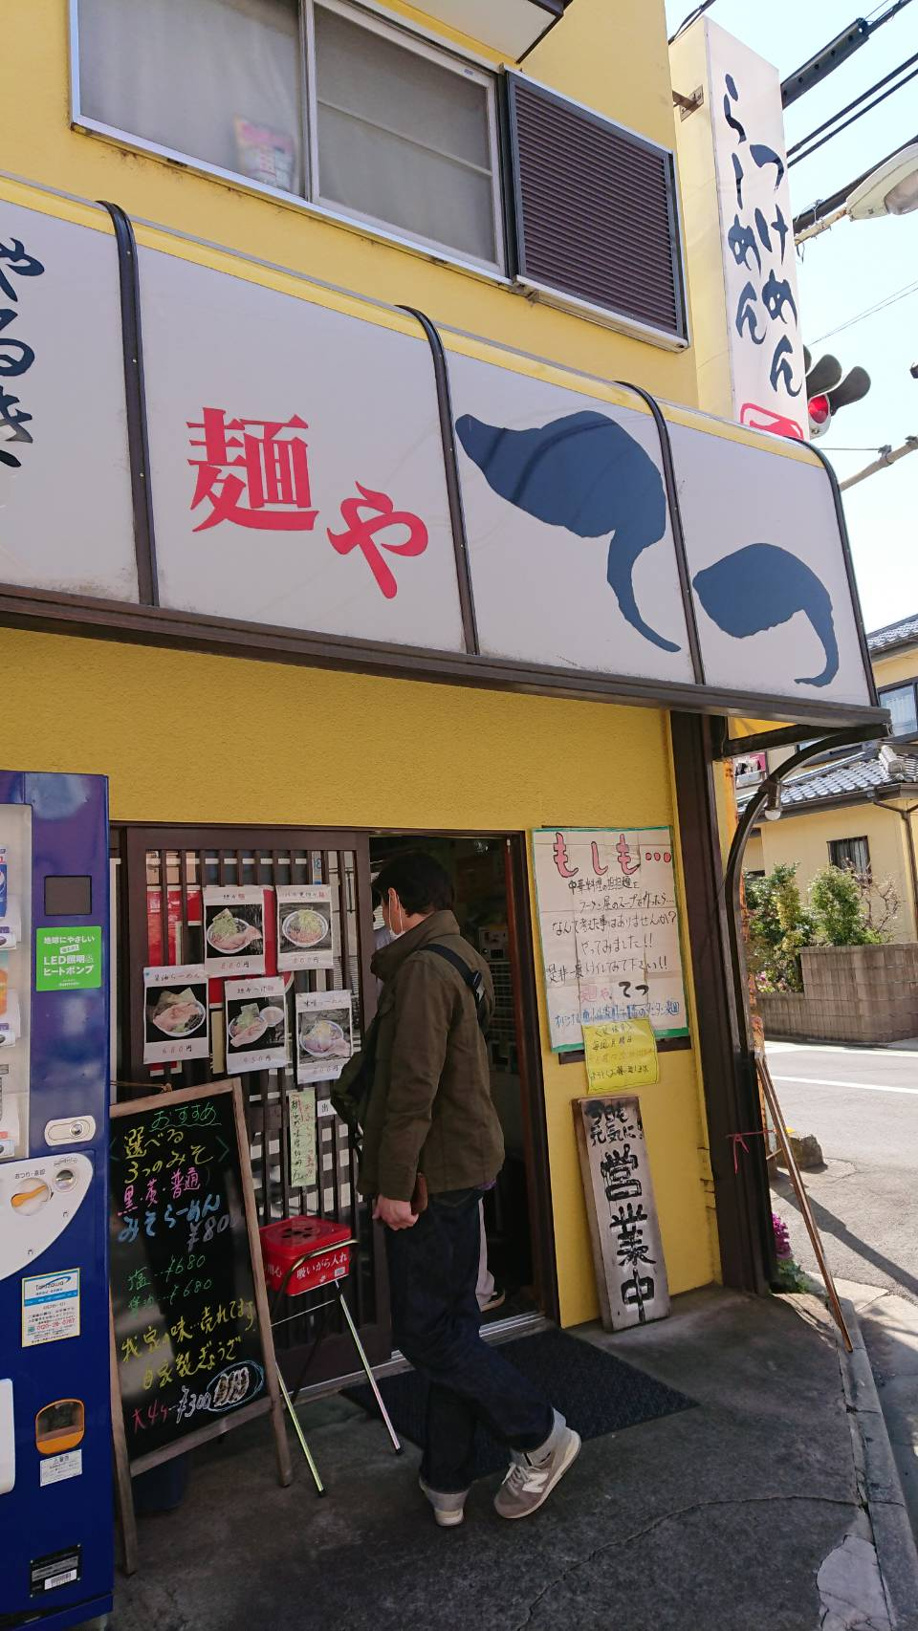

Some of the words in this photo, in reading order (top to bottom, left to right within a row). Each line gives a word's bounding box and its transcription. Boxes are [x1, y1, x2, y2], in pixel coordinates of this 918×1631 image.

[724, 73, 767, 345] らーめん
[749, 143, 802, 397] つけめん
[186, 406, 429, 599] 麺や
[43, 935, 95, 945] 地球にやさしい
[43, 964, 94, 977] ヒートポンプ
[151, 1102, 217, 1129] おすすめ
[124, 1126, 184, 1159] 選べる
[117, 1193, 221, 1243] みそらーめん
[600, 1143, 656, 1323] 営業中
[296, 1252, 348, 1279] 吸いがら入れ
